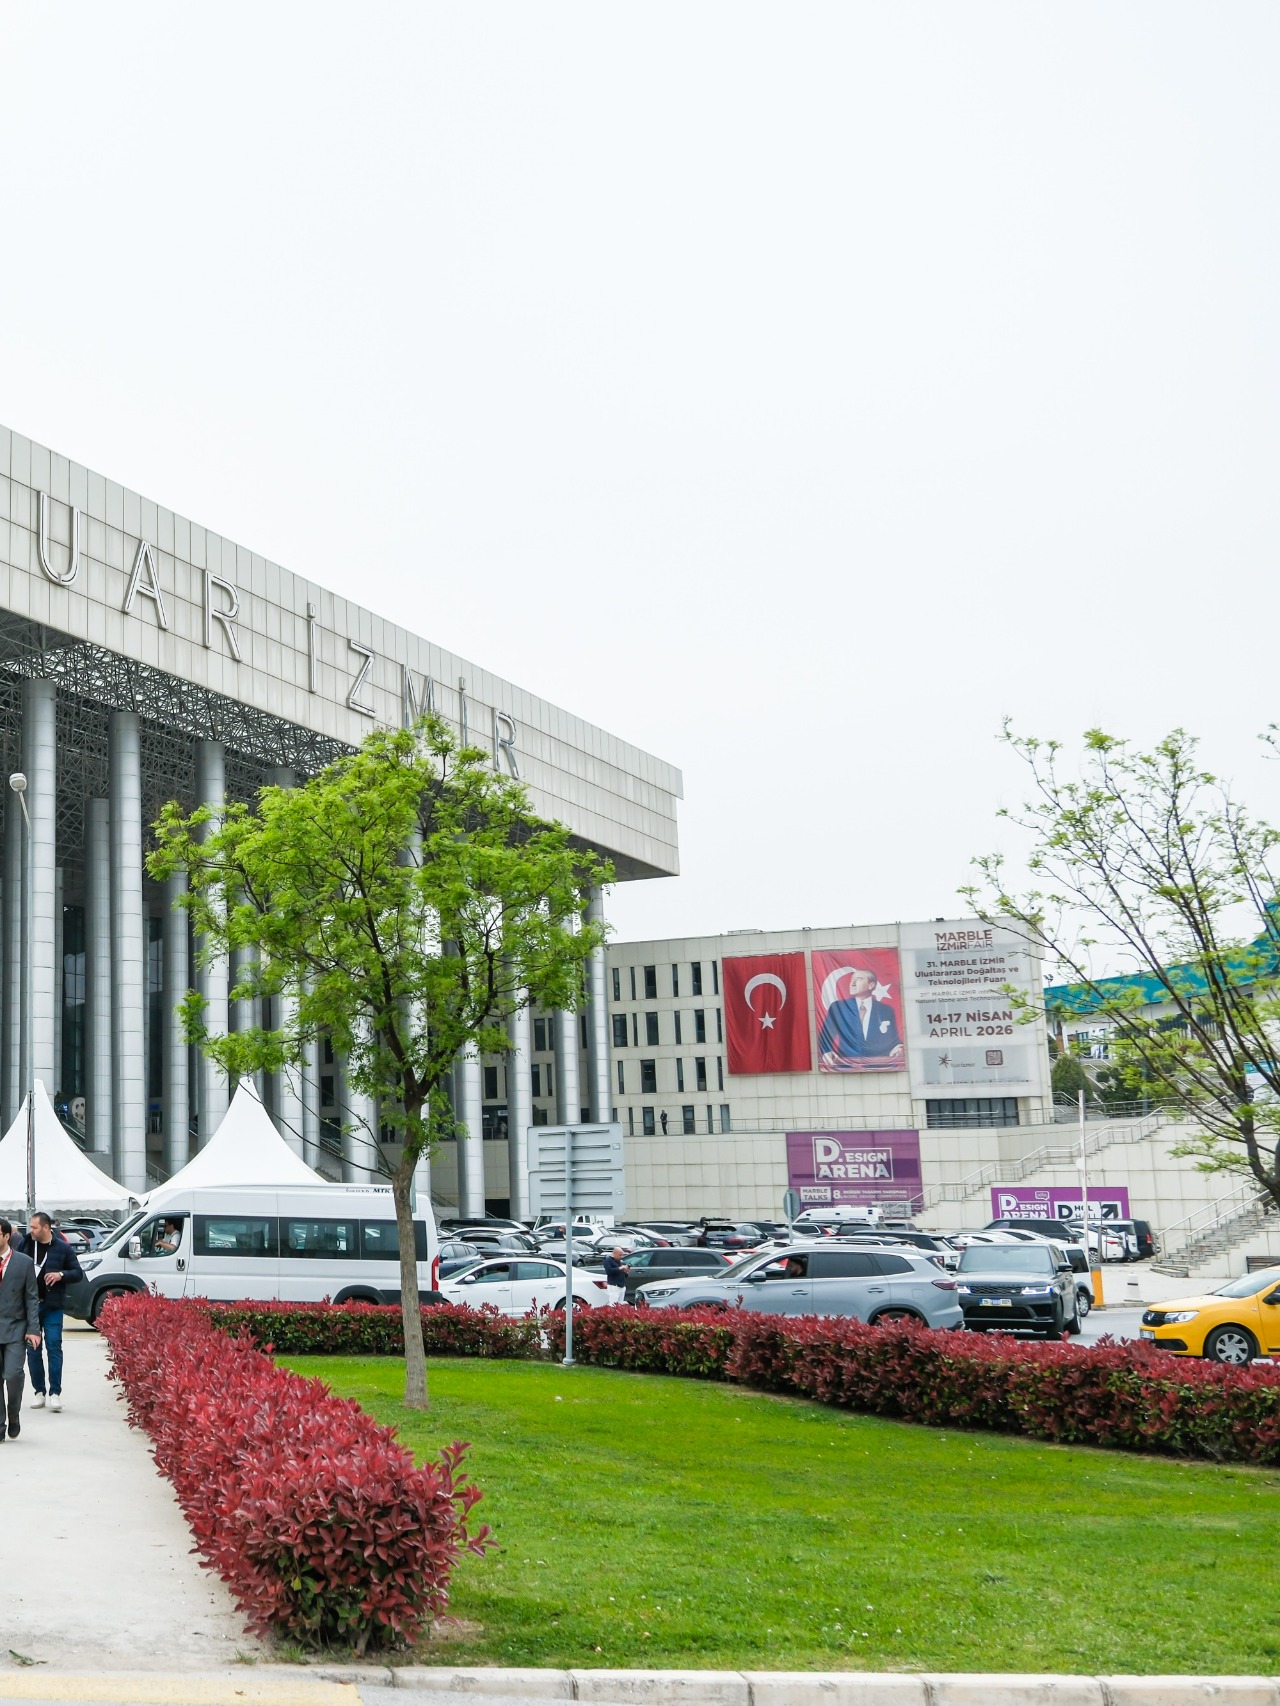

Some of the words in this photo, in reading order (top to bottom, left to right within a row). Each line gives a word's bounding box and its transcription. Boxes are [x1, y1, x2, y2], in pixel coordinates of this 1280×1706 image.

[306, 602, 520, 780] İZMİR
[935, 929, 993, 942] MARBLE
[940, 958, 978, 967] MARBLE
[979, 957, 1005, 966] İZMİR
[915, 969, 965, 978] Uluslararası
[966, 967, 1007, 976] Doğaltaş
[928, 977, 982, 987] Teknolojileri
[926, 1012, 962, 1024] 14-17
[966, 1009, 1013, 1022] NİSAN
[929, 1026, 972, 1038] APRIL
[976, 1024, 1014, 1036] 2026
[818, 1163, 890, 1178] ARENA
[833, 1189, 843, 1199] 8.
[1003, 1211, 1050, 1219] ARENA
